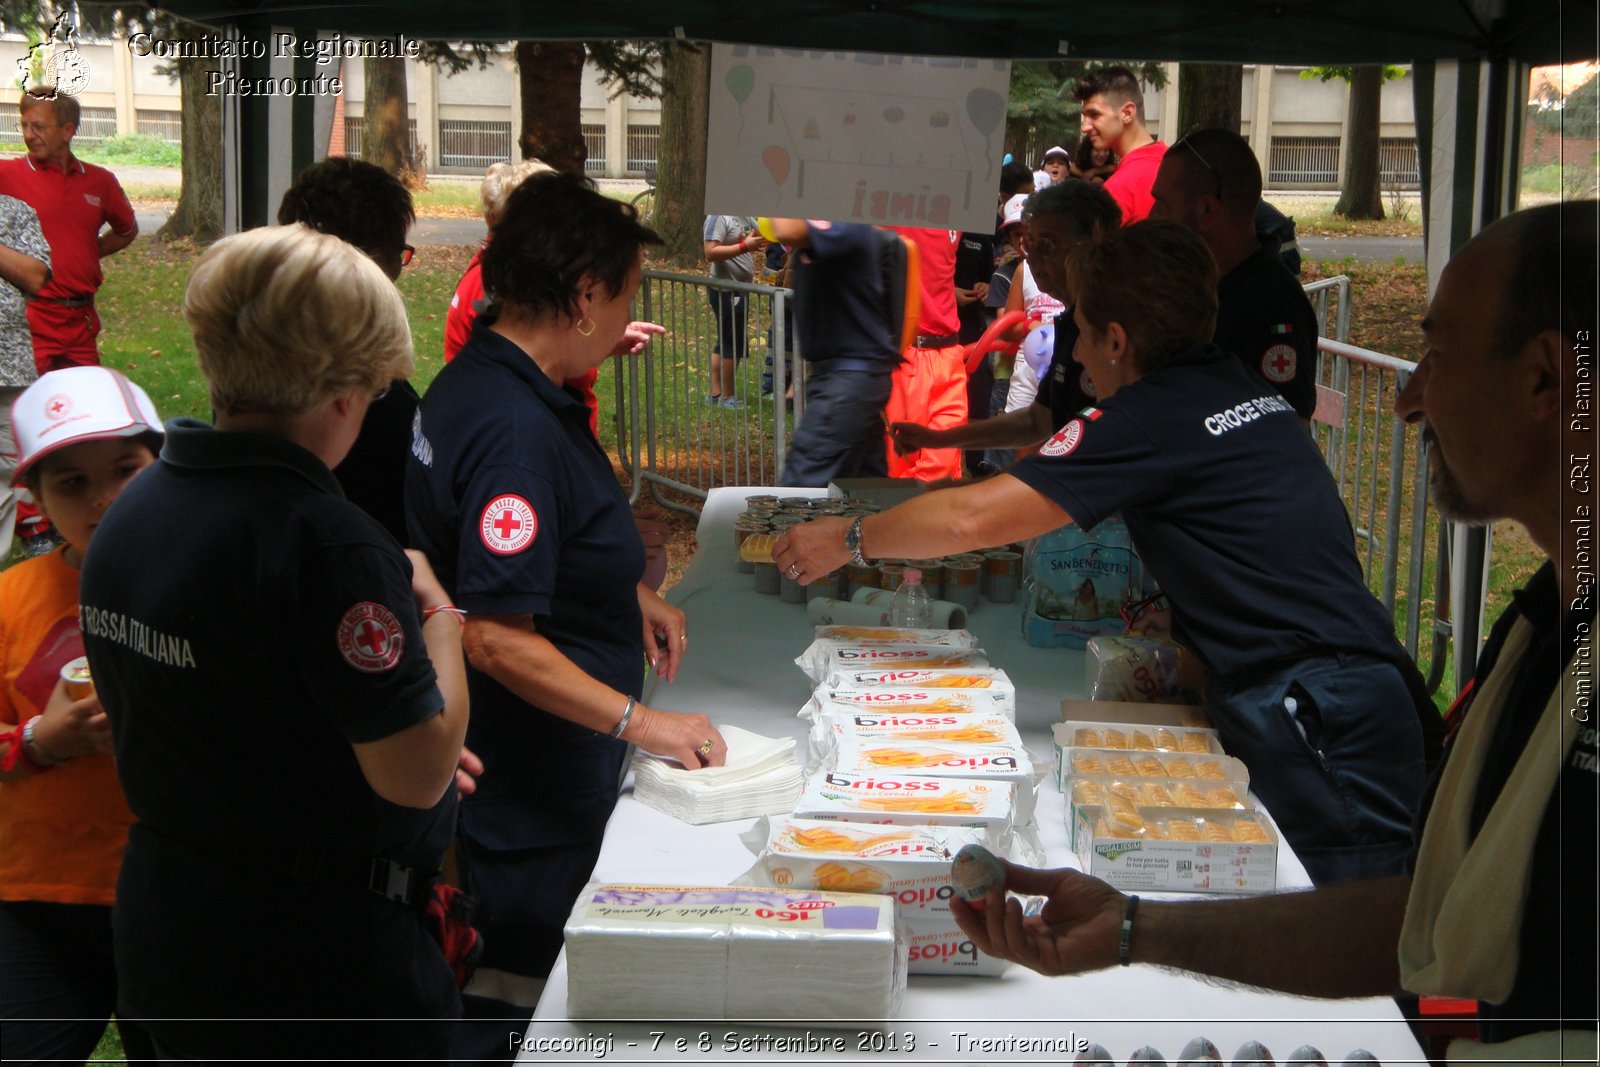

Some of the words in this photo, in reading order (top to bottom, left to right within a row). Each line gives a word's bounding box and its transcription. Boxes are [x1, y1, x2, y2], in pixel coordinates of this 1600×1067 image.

[1204, 401, 1260, 436] CROCE
[1051, 559, 1072, 571] SAN
[1072, 558, 1129, 575] BENEDETTO
[85, 605, 128, 646] ROSSA
[128, 617, 197, 669] ITALIANA
[838, 649, 928, 659] brioss
[855, 716, 958, 727] brioss
[825, 773, 941, 791] brioss
[755, 908, 816, 922] 160
[909, 940, 978, 964] brios
